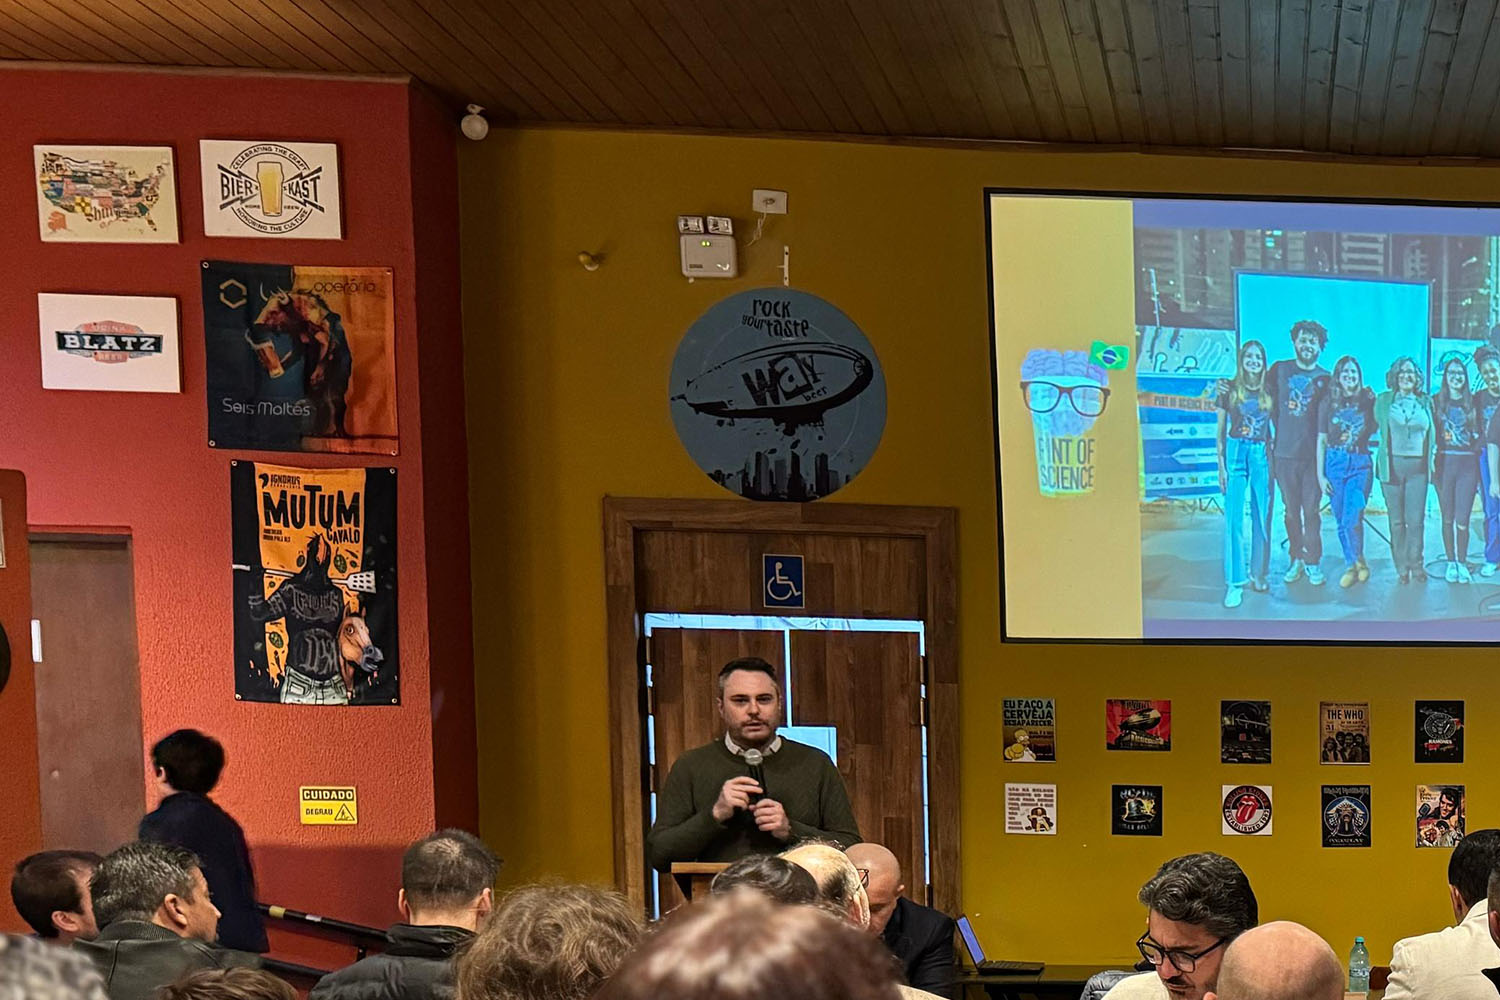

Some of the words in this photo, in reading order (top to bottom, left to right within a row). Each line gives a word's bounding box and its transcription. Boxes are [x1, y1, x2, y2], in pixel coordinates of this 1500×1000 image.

[233, 146, 273, 170] CELEBRATING
[275, 147, 288, 155] THE
[288, 153, 307, 171] CRAFT
[220, 172, 253, 201] BIER
[288, 175, 320, 203] KAST
[283, 210, 308, 230] CULTURE
[753, 299, 791, 318] rock
[766, 319, 809, 337] taste
[63, 334, 156, 351] BLATZ
[802, 385, 828, 402] beer
[222, 398, 255, 415] Seis
[1039, 438, 1072, 465] PINT
[1078, 438, 1096, 464] OF
[1040, 464, 1095, 490] SCIENCE
[262, 485, 360, 530] MUTUM
[326, 527, 360, 544] CAVALO
[1004, 700, 1016, 709] EU
[1018, 700, 1043, 711] FAÇO
[1046, 700, 1053, 709] A
[1327, 709, 1342, 720] THE
[1344, 709, 1364, 720] WHO
[1004, 710, 1053, 720] CERVEJA
[303, 790, 353, 800] CUIDADO
[1225, 810, 1261, 831] ESTABLISHED
